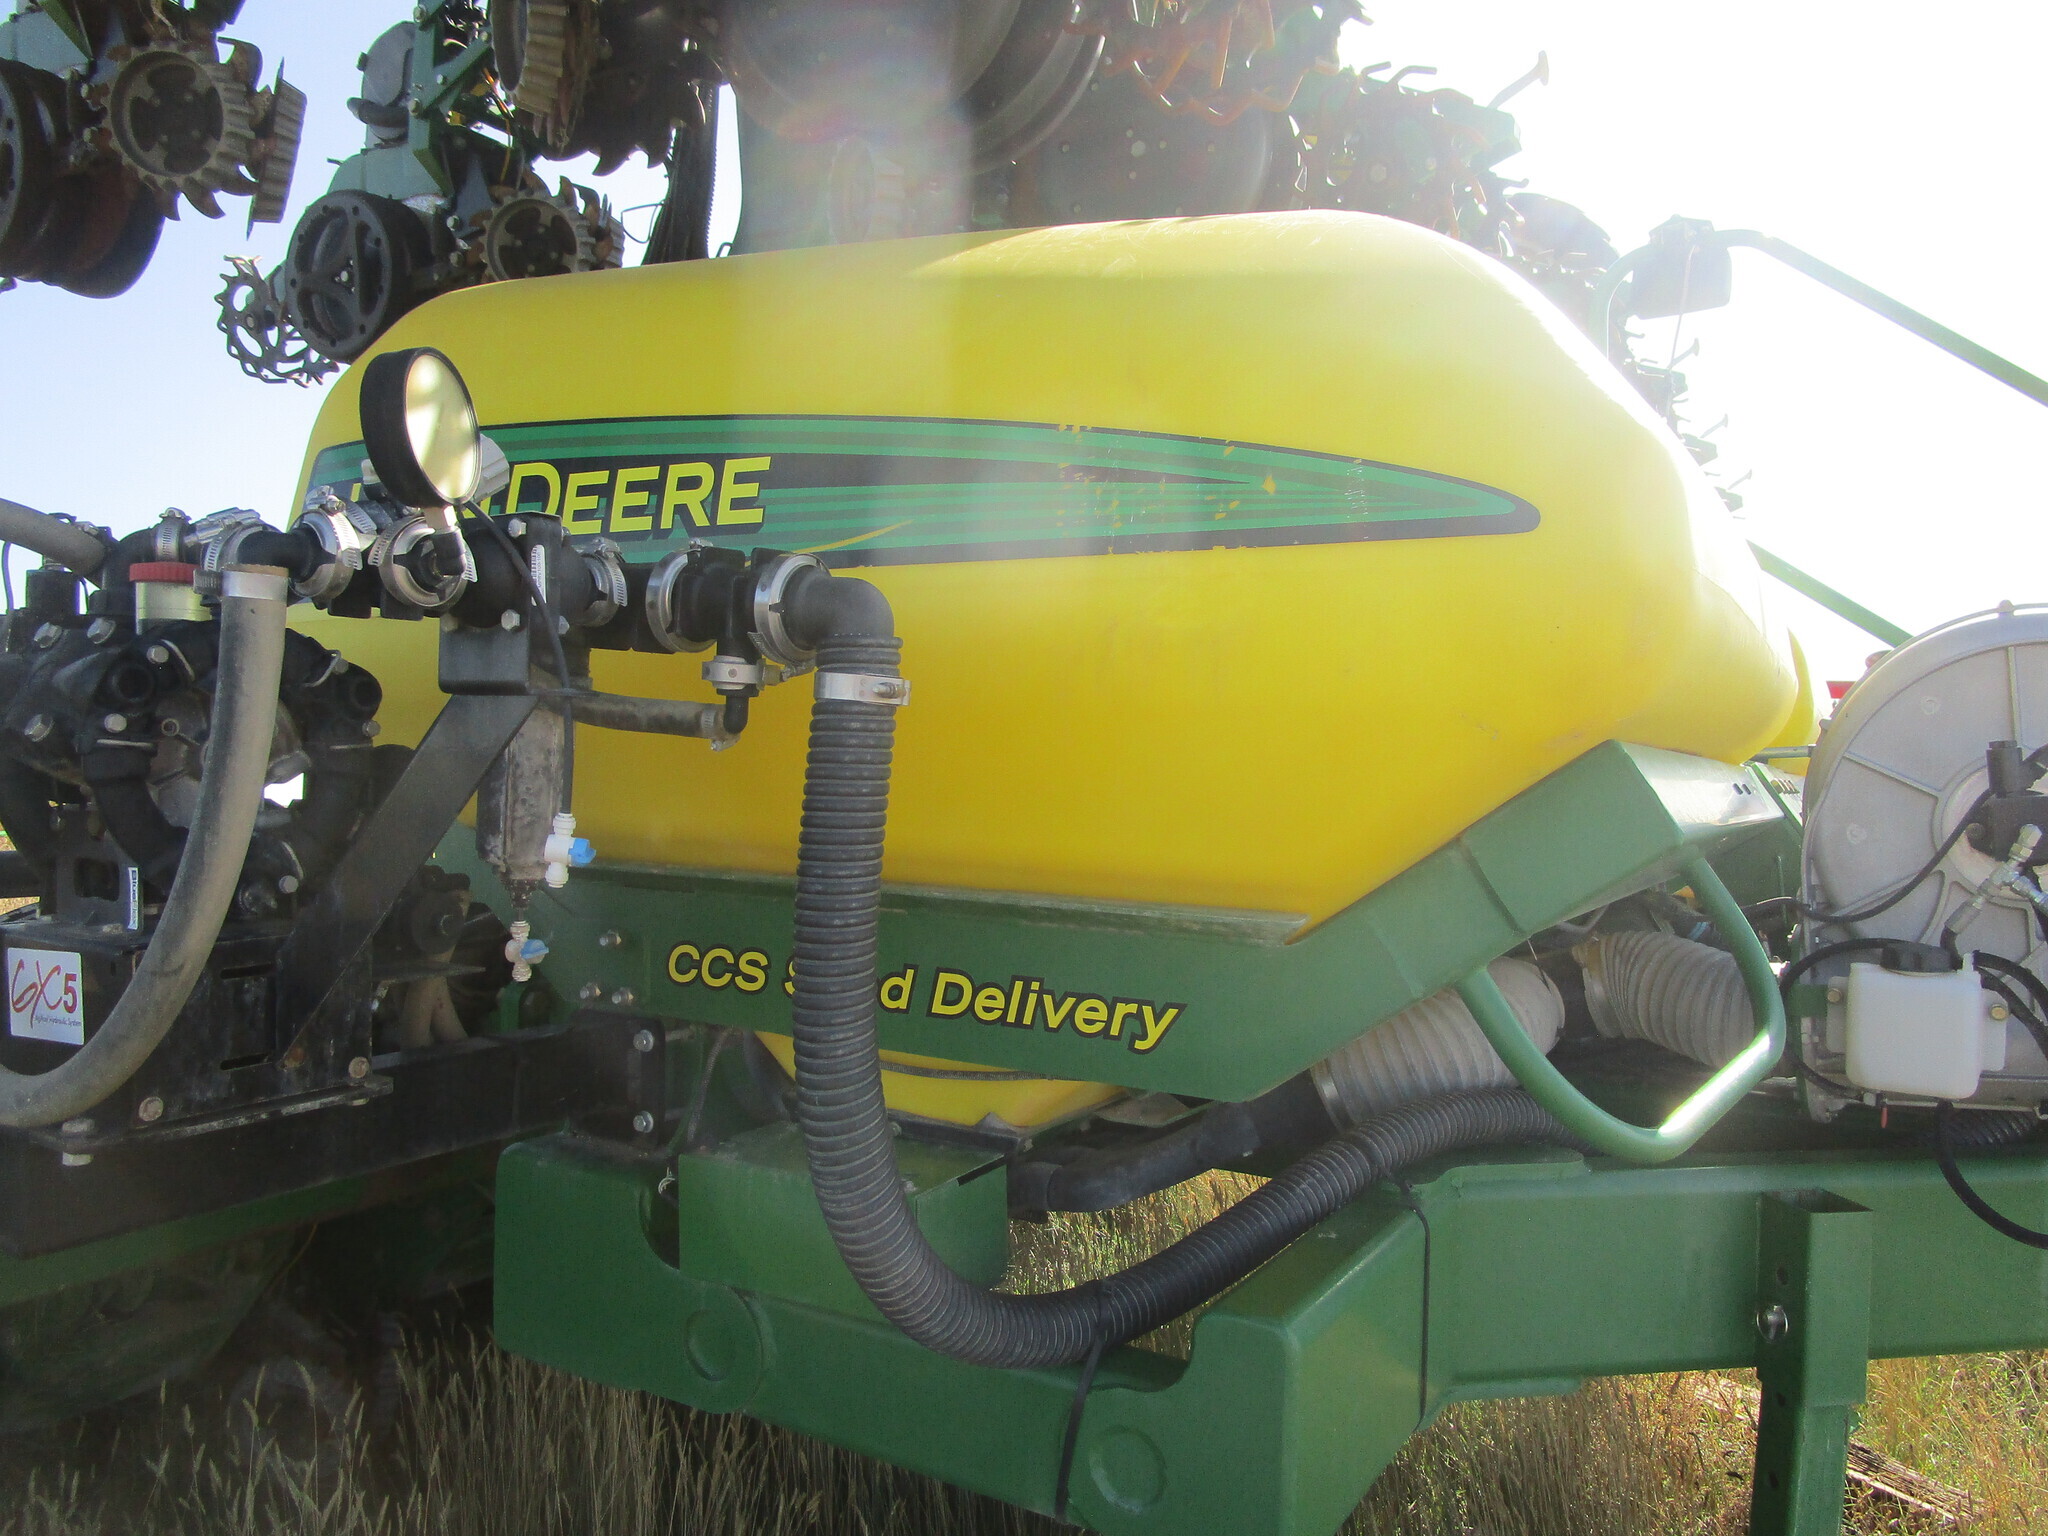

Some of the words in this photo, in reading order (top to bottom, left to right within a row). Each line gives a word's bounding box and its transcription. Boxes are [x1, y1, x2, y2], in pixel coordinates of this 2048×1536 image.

[505, 456, 771, 536] DEERE
[667, 944, 768, 992] CCS
[931, 971, 1179, 1050] Delivery
